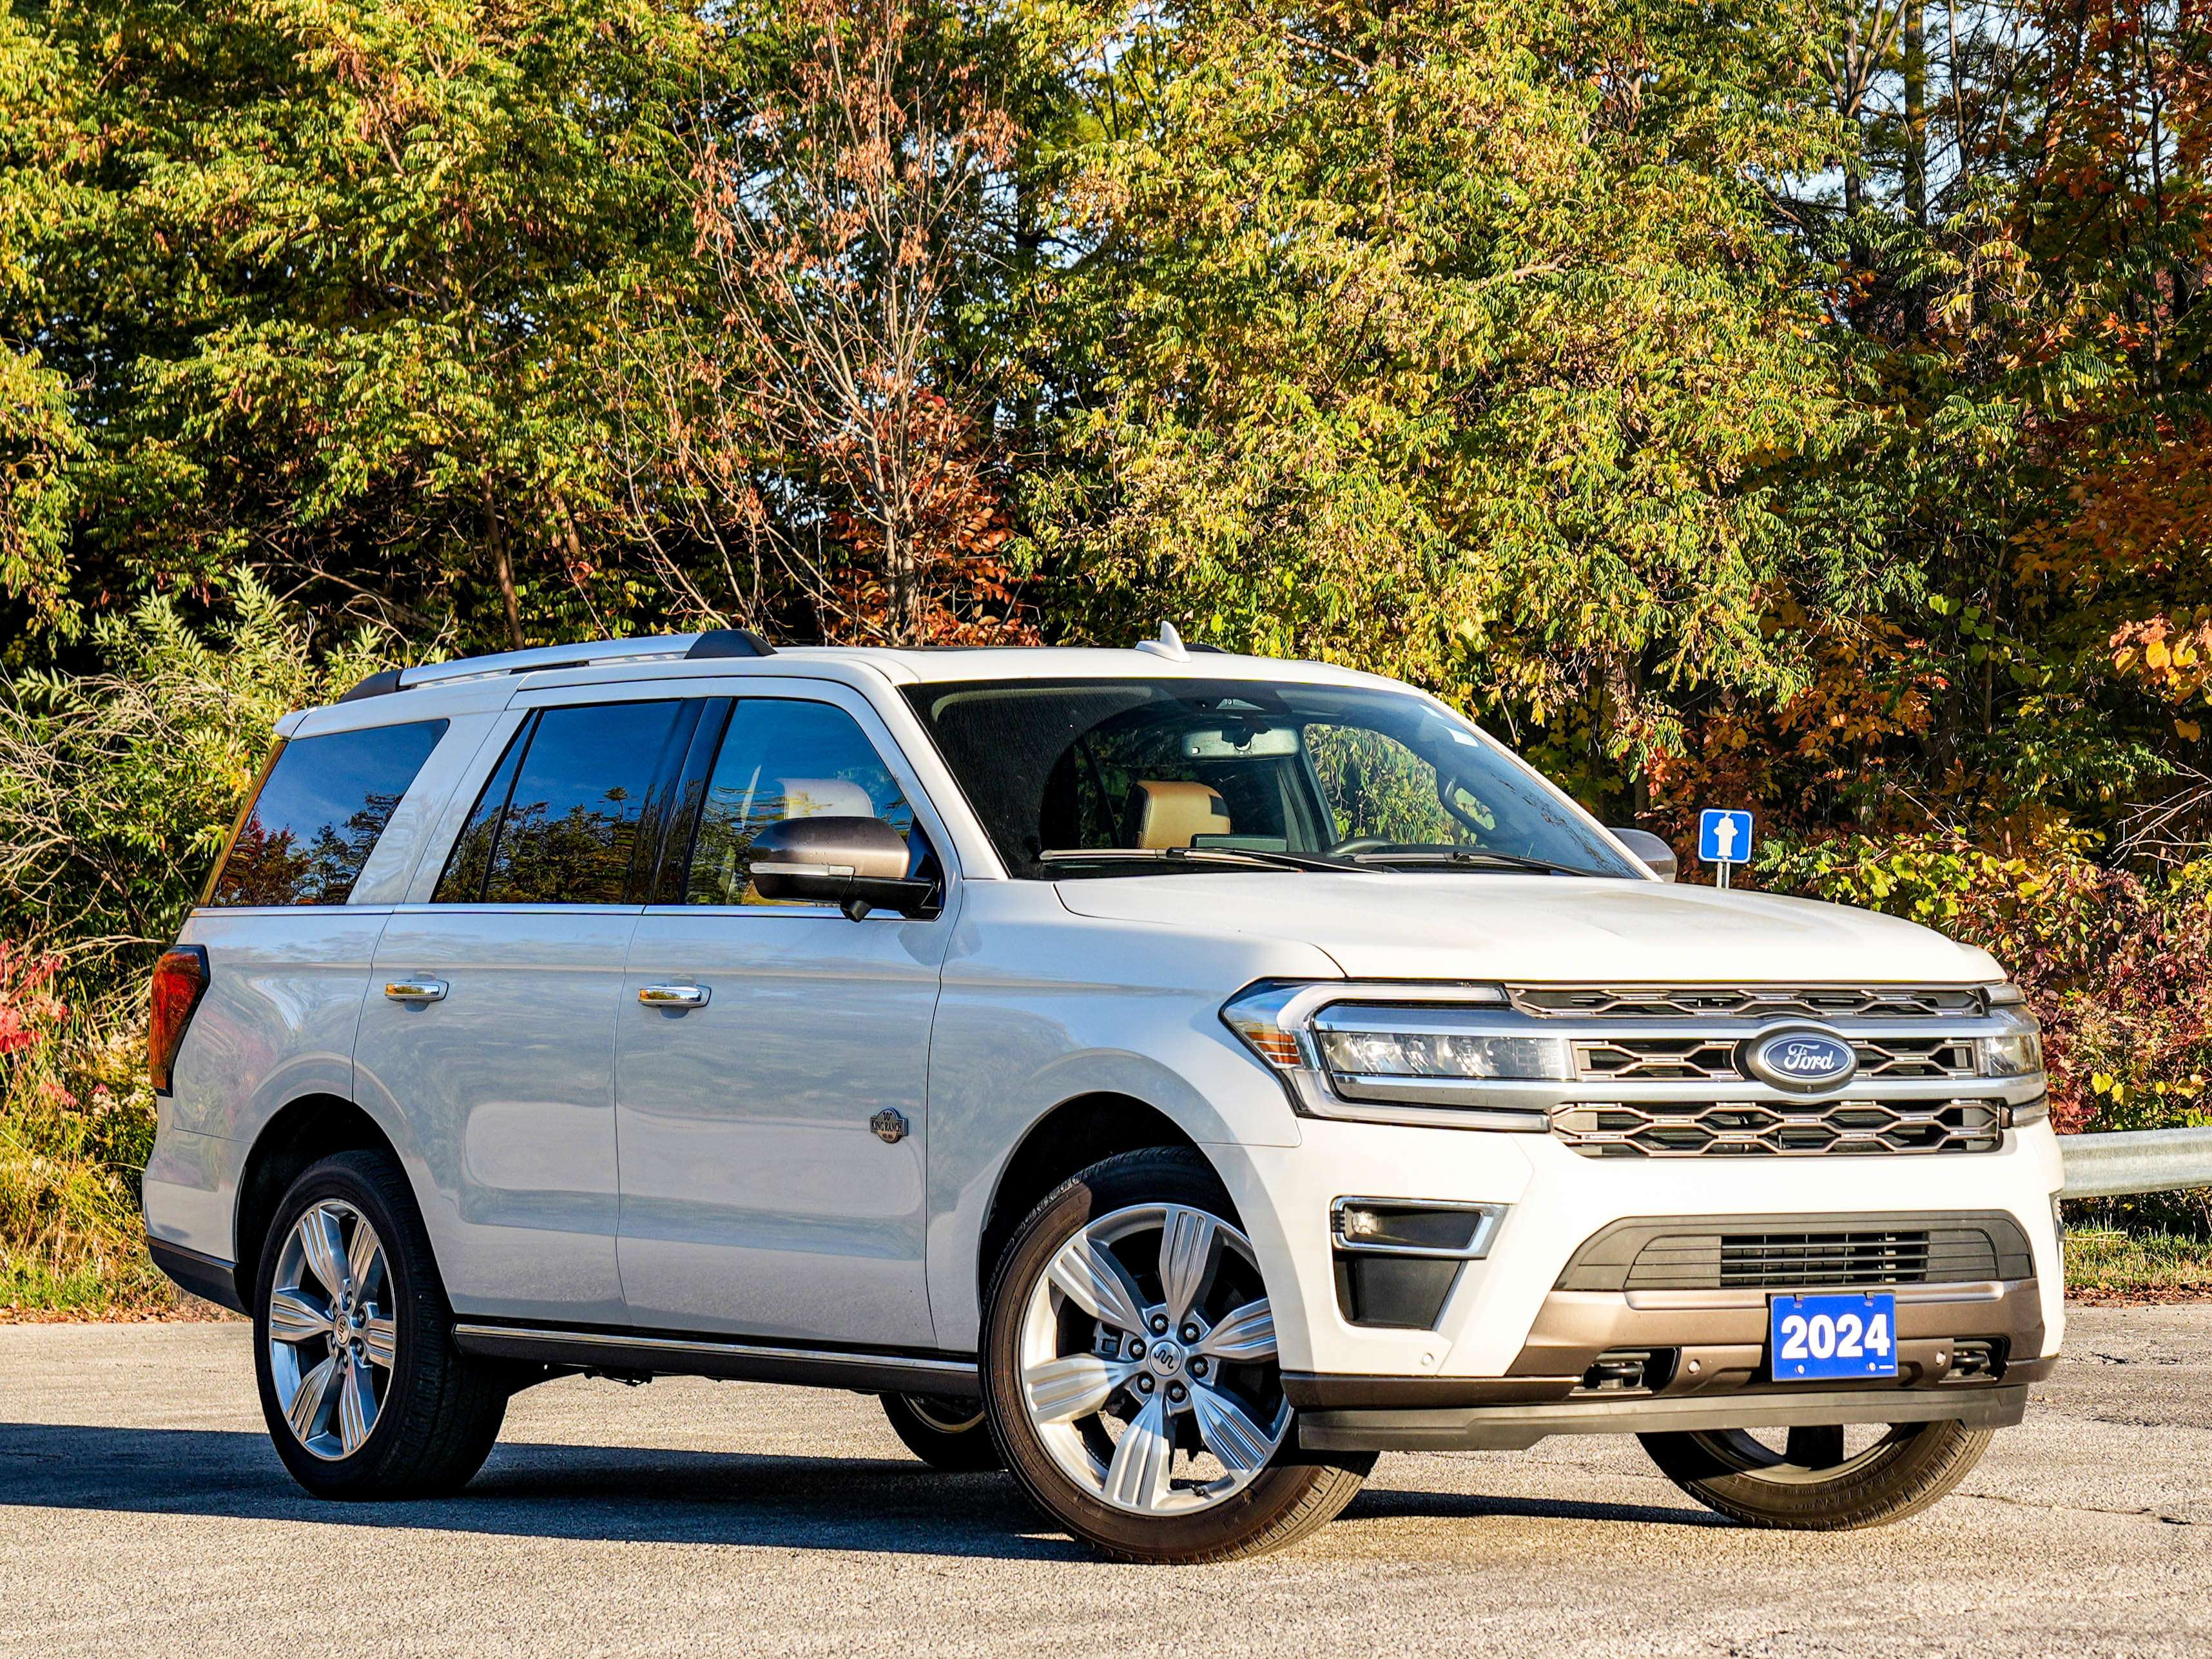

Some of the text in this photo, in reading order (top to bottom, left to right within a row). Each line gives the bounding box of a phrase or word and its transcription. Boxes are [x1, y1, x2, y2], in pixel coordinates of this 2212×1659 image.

[1784, 1043, 1834, 1070] Ford
[871, 1119, 902, 1132] KING RANCH
[1781, 1314, 1890, 1359] 2024
